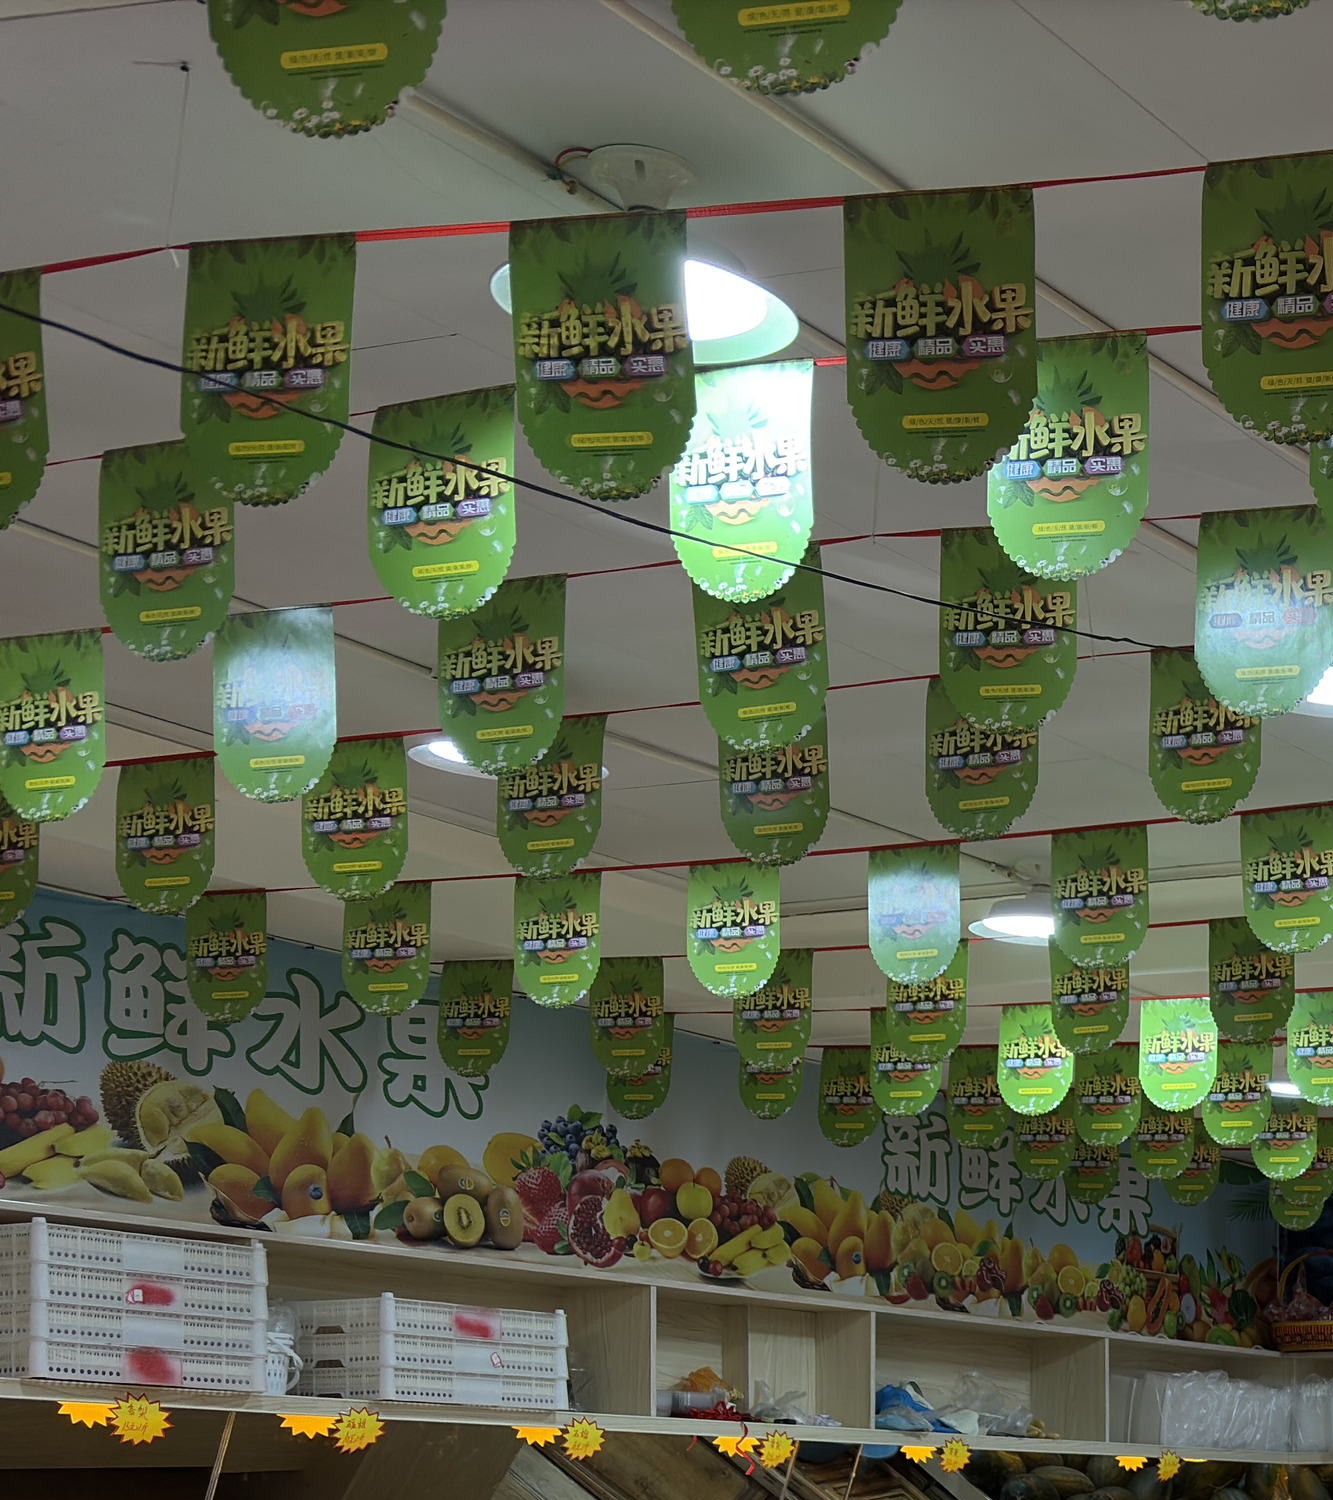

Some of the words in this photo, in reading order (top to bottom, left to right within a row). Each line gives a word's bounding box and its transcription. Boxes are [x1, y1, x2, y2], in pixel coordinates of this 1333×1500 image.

[851, 280, 1033, 339] 新鲜水果
[1226, 300, 1259, 318] 健康
[1277, 295, 1314, 315] 精品
[188, 318, 350, 372] 新鲜水果
[518, 302, 687, 359] 新鲜水果
[869, 341, 901, 357] 健康
[918, 338, 953, 356] 精品
[969, 336, 1004, 353] 实惠
[538, 361, 568, 377] 健康
[583, 358, 615, 376] 精品
[630, 356, 663, 373] 实惠
[372, 457, 511, 508] 新鲜水果
[103, 507, 234, 555] 新鲜水果
[944, 590, 1076, 631] 新鲜水果
[699, 609, 824, 657] 新鲜水果
[441, 636, 563, 679] 新鲜水果
[501, 763, 601, 799] 新鲜水果
[120, 804, 215, 837] 新鲜水果
[305, 787, 407, 821] 新鲜水果
[1054, 868, 1148, 898] 新鲜水果
[518, 912, 600, 940] 新鲜水果
[690, 900, 778, 928] 新鲜水果
